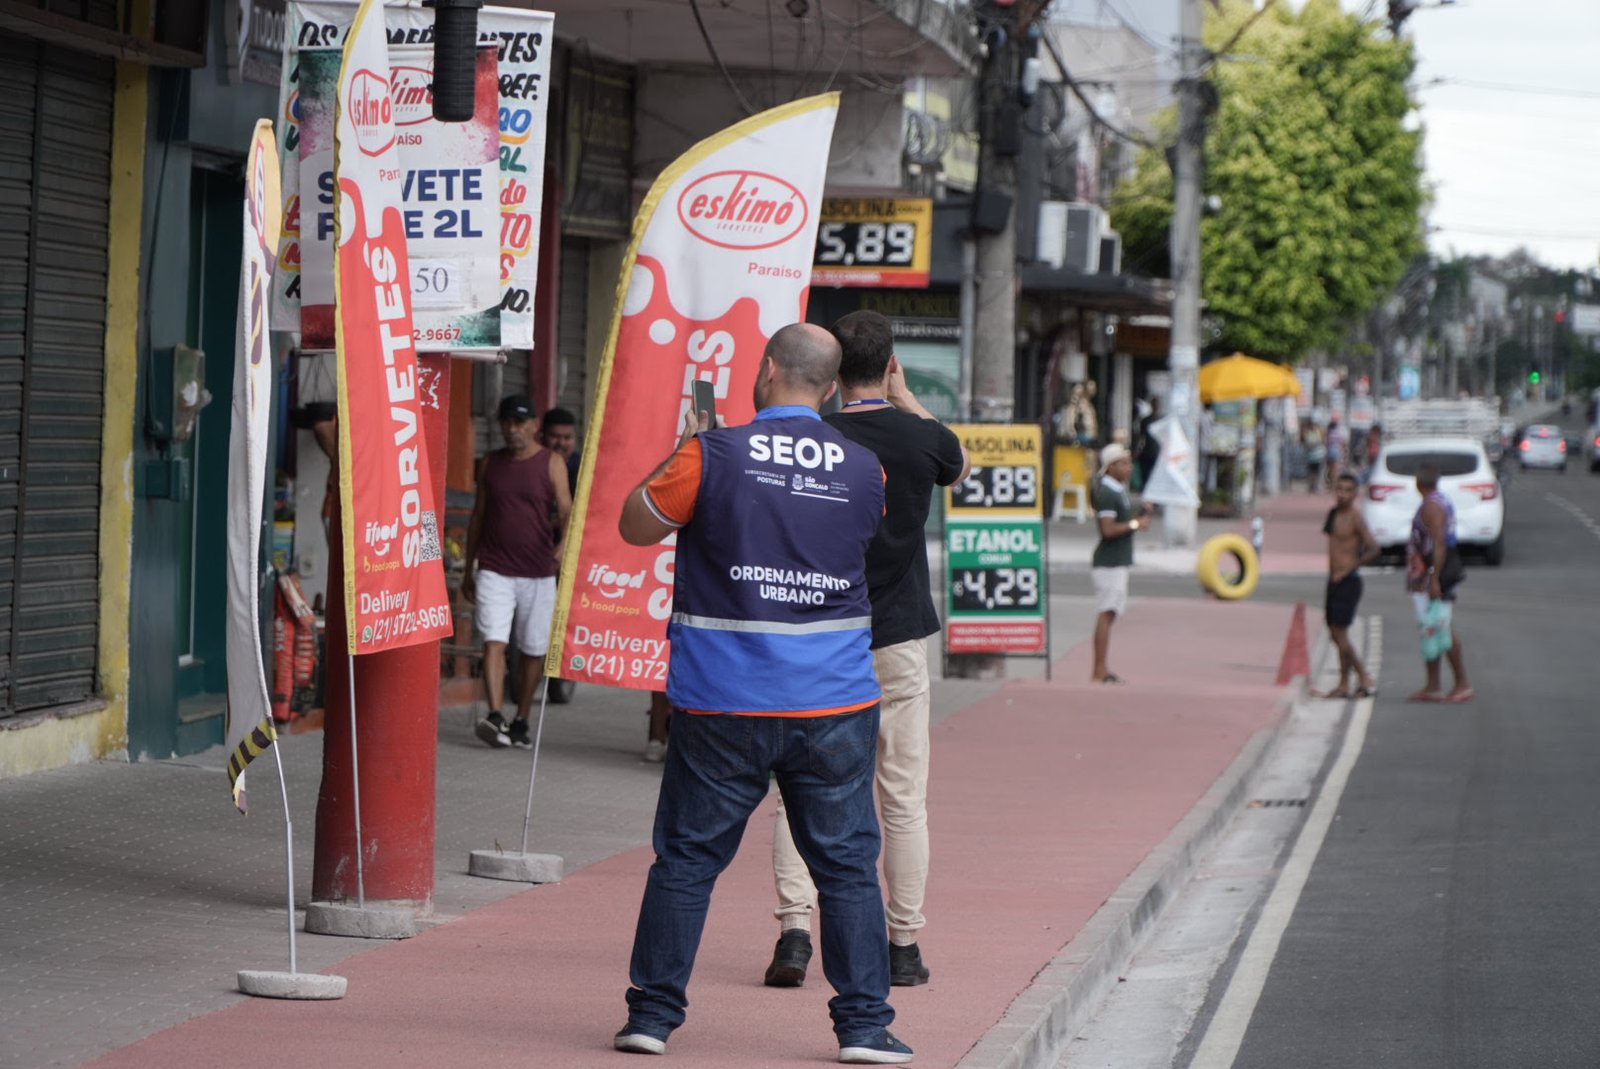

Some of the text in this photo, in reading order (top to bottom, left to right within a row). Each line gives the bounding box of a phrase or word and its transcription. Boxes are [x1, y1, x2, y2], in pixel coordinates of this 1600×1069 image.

[434, 209, 482, 238] 2L
[371, 246, 421, 569] SORVETES
[749, 434, 845, 472] SEOP
[756, 476, 787, 487] POSTURAS
[949, 529, 1040, 553] ETANOL
[587, 564, 647, 589] ifood
[729, 565, 851, 591] ORDENAMENTO
[361, 590, 410, 615] Delivery
[760, 584, 825, 606] URBANO
[573, 625, 666, 660] Delivery
[586, 653, 625, 681] (21)
